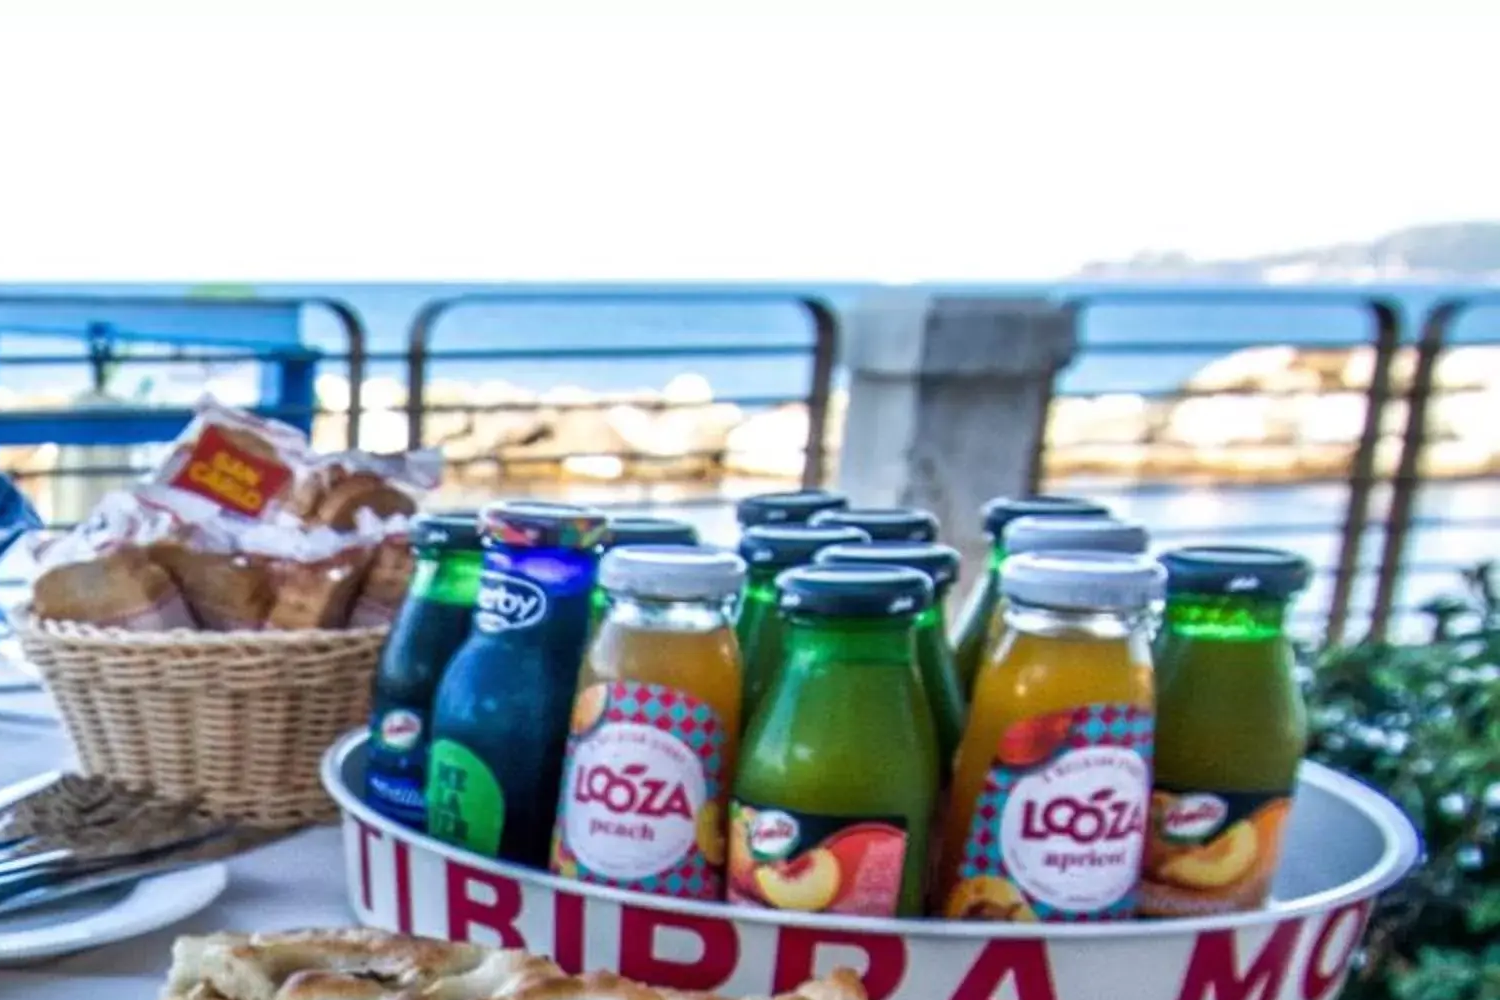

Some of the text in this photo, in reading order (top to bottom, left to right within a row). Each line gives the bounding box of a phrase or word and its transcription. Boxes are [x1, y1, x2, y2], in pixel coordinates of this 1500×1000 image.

[575, 763, 693, 821] LOOZA
[590, 818, 656, 842] peach
[1021, 796, 1144, 845] LOOZA
